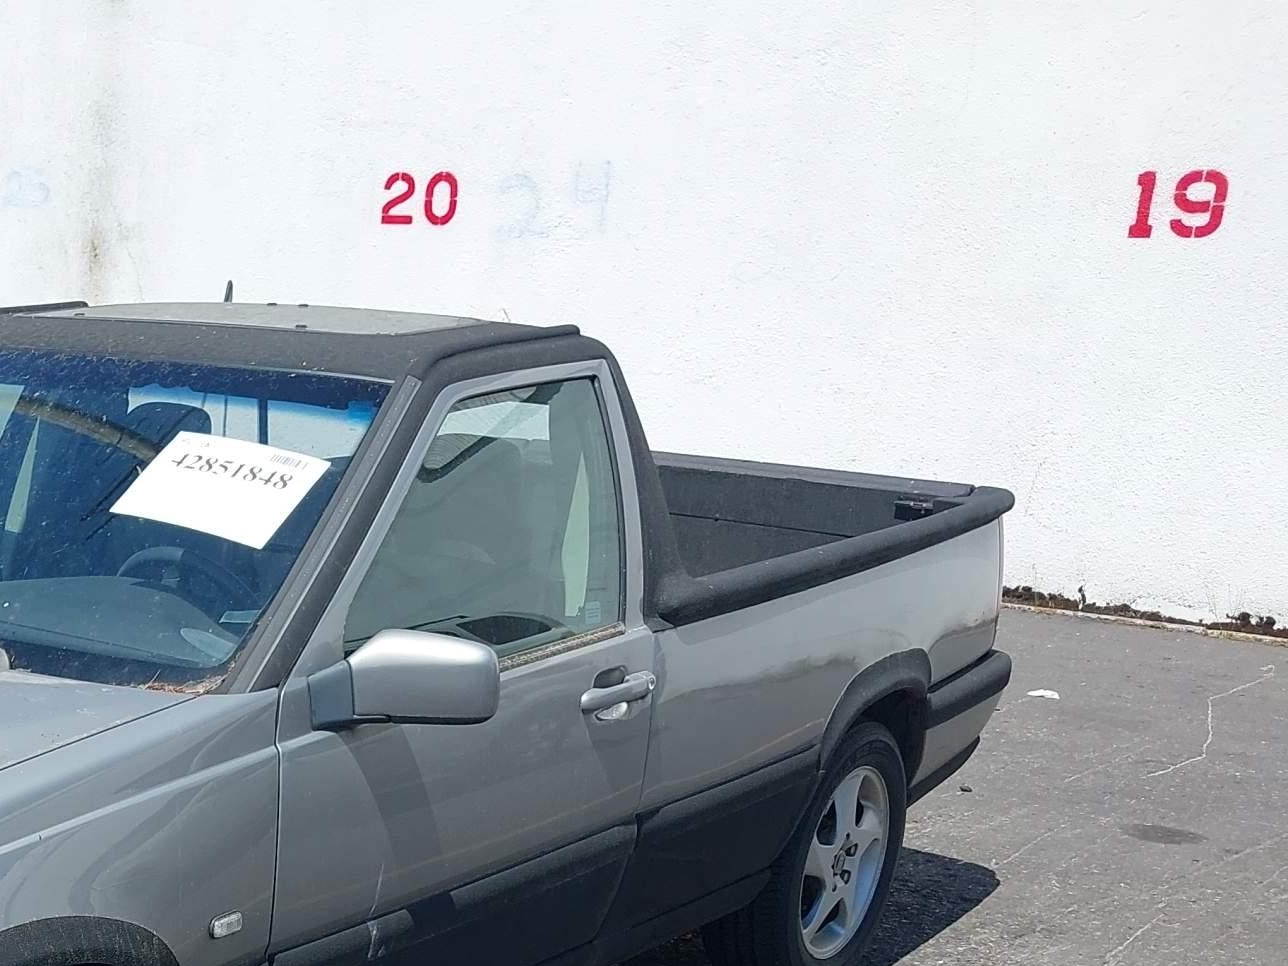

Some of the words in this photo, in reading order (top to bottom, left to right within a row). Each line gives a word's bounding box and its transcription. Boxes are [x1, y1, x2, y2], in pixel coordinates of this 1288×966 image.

[381, 171, 458, 226] 20
[1128, 169, 1229, 238] 19
[171, 453, 294, 489] 42851848
